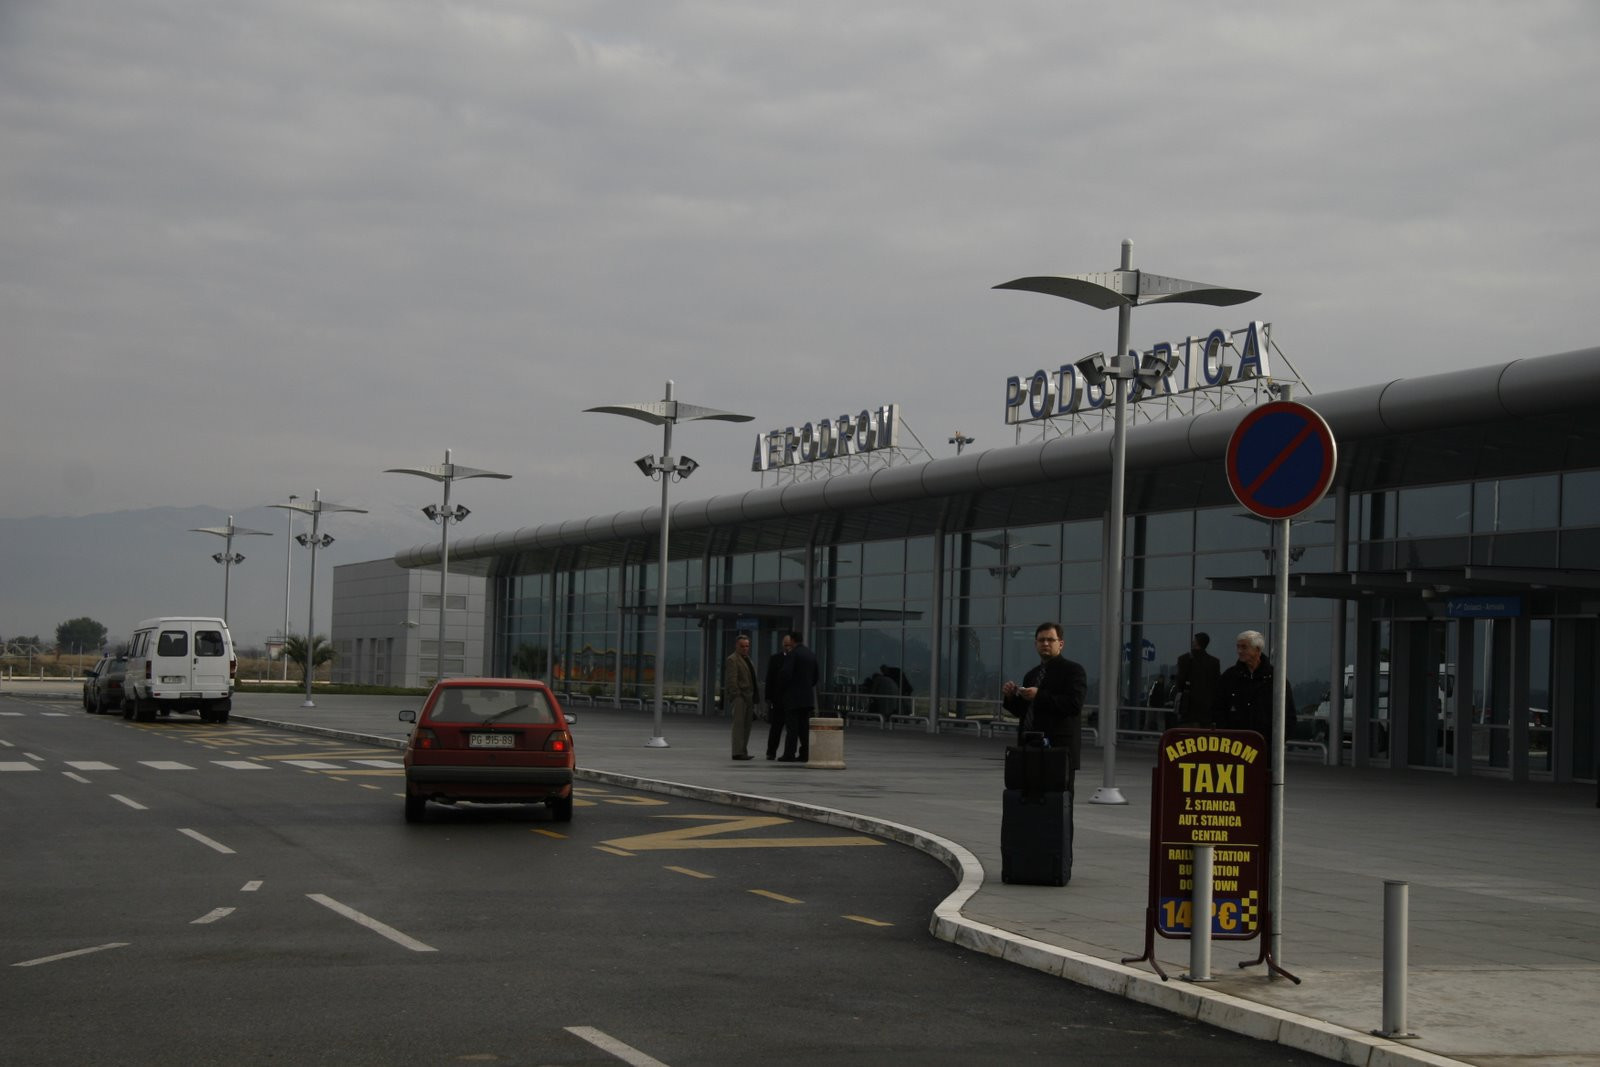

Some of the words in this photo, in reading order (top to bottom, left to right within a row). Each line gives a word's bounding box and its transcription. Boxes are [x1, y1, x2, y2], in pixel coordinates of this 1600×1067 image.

[752, 404, 900, 471] AERODROM
[471, 735, 482, 744] PG
[1165, 736, 1259, 765] AERODROM
[1178, 763, 1245, 794] TAXI
[1185, 797, 1193, 811] Ž.
[1194, 799, 1236, 812] STANICA
[1178, 814, 1199, 826] AUT.
[1200, 815, 1242, 827] STANICA
[1191, 829, 1229, 842] CENTAR
[1178, 864, 1193, 876] BU
[1213, 865, 1240, 877] ATION
